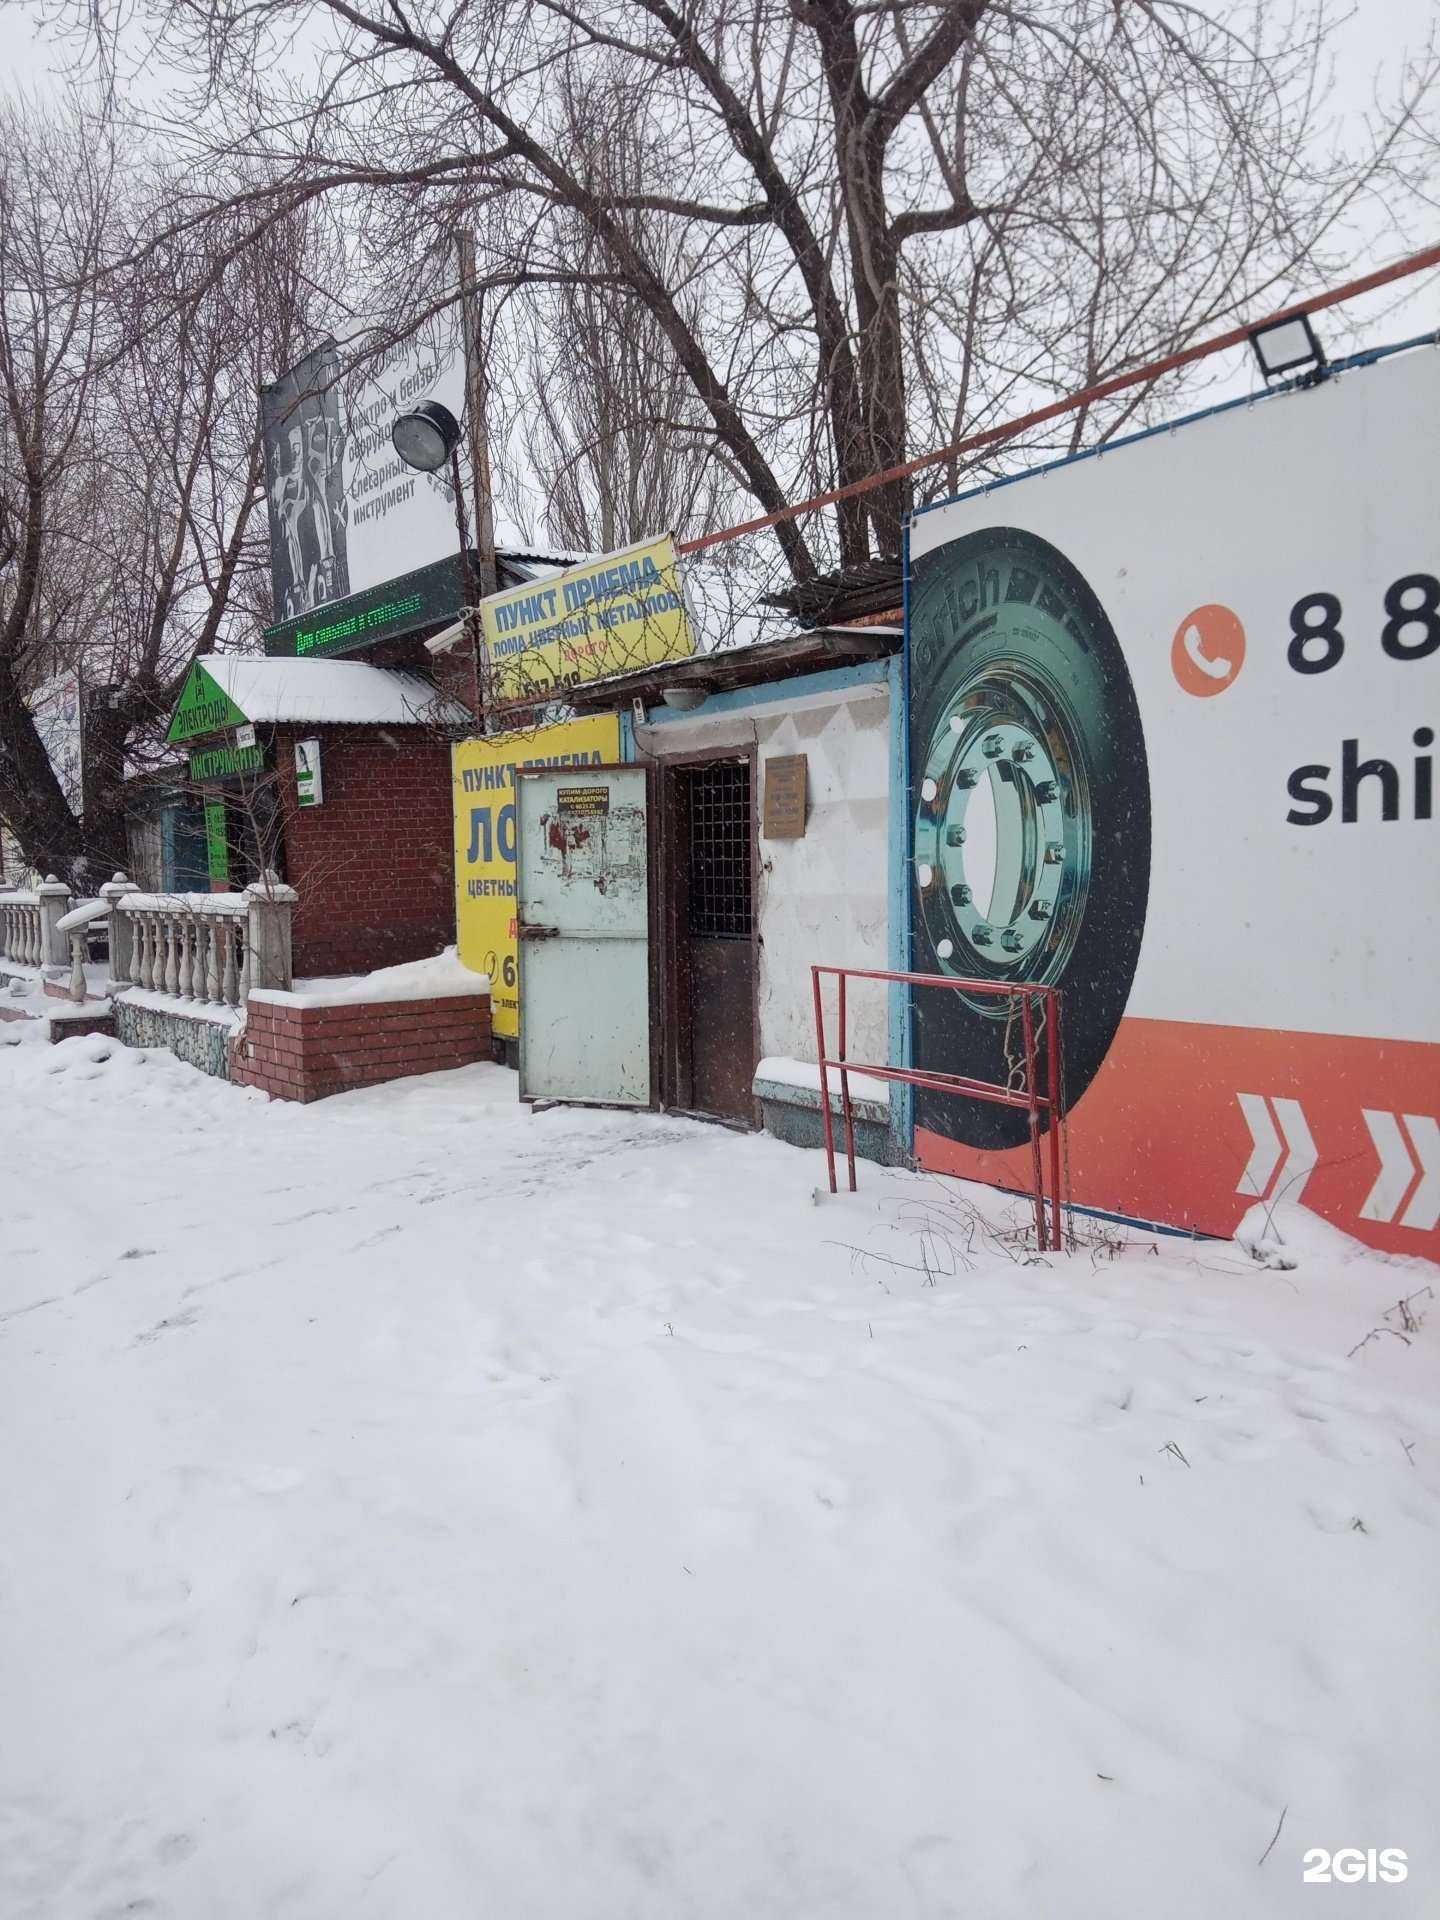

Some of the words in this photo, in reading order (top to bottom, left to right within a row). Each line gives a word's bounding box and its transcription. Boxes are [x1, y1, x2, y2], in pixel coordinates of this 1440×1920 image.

[353, 478, 415, 526] инструмент
[495, 587, 556, 633] ПУНКТ
[561, 555, 661, 612] ПРИЕМА
[492, 636, 528, 659] ЛОМА
[1287, 592, 1345, 675] 8
[1381, 573, 1440, 661] 8
[178, 696, 230, 733] ЭЛЕКТРОДЫ
[462, 763, 516, 793] ПУНКТ
[1286, 726, 1435, 827] shi
